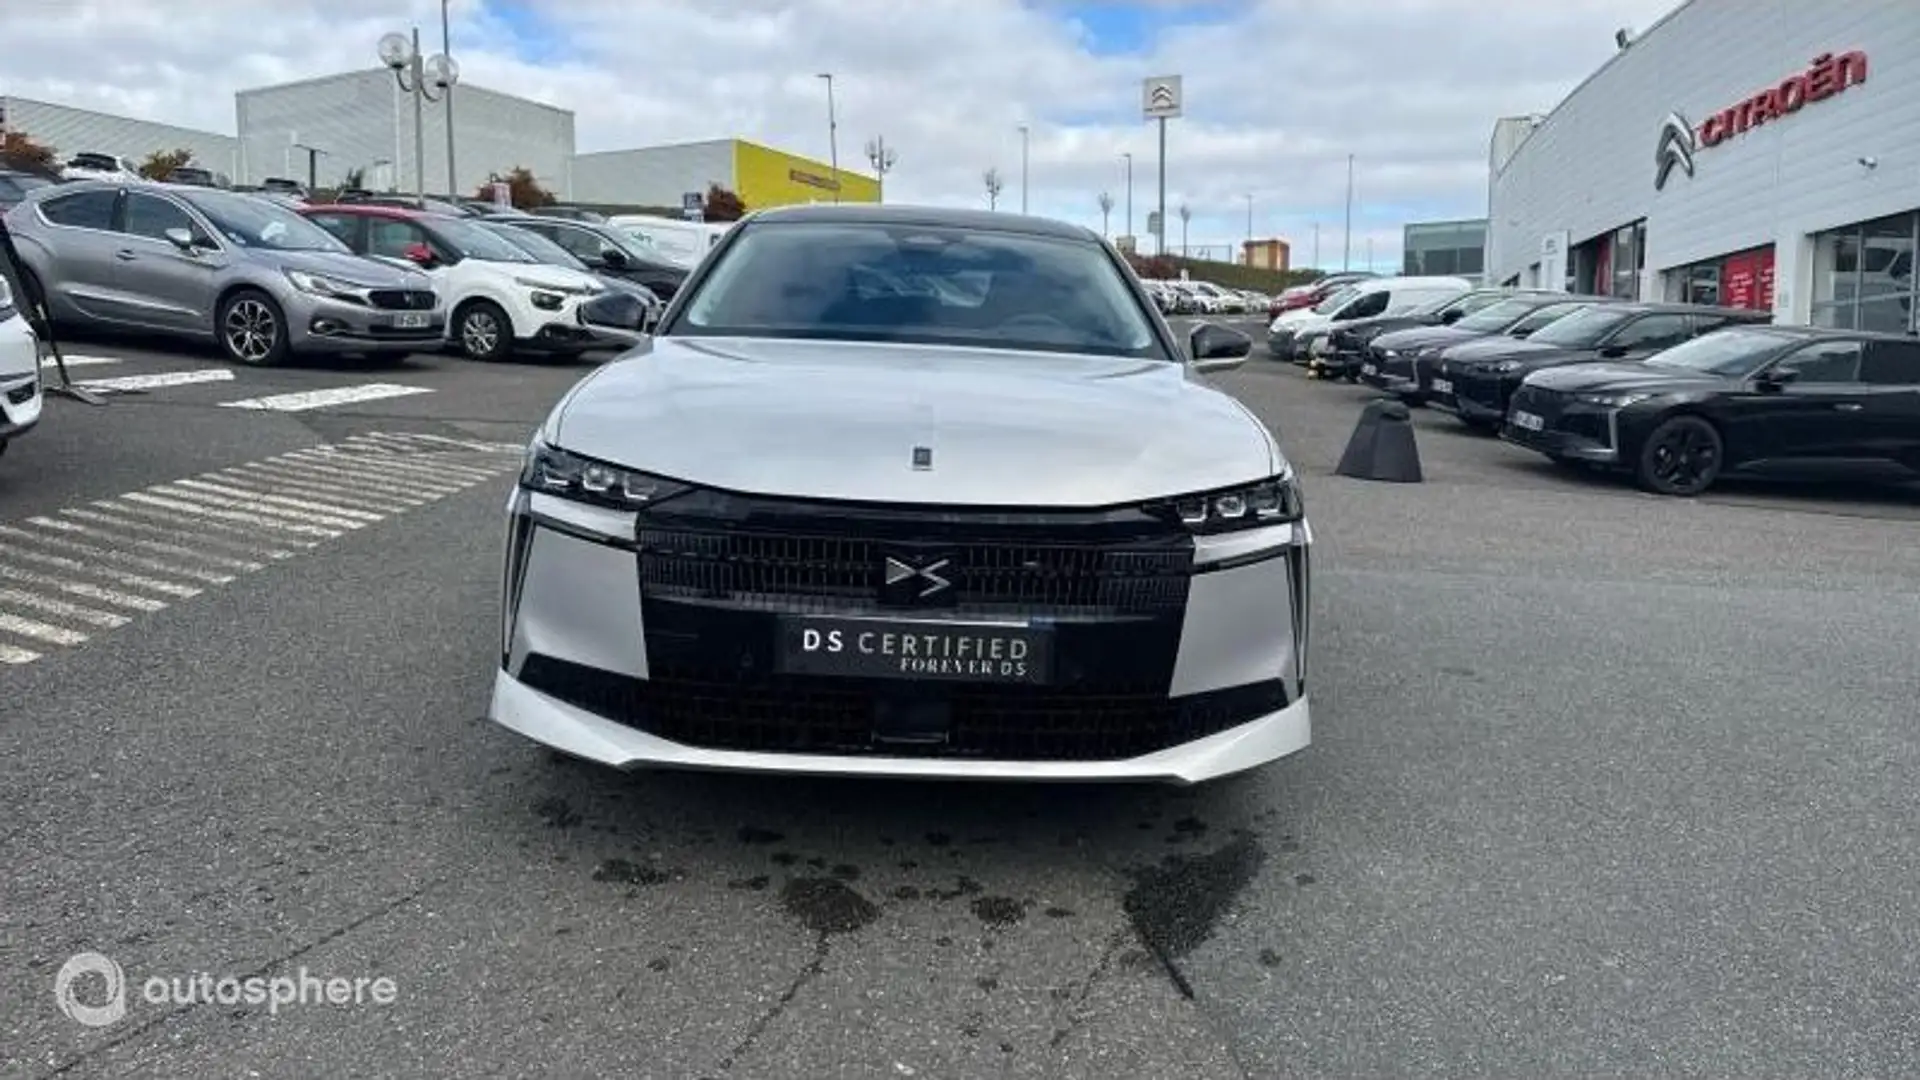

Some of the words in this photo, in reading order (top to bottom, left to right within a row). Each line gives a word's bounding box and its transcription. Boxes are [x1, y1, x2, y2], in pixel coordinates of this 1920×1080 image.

[803, 629, 843, 652] DS
[859, 632, 1027, 659] CERTIFIED
[900, 657, 993, 675] FOREVER
[1001, 661, 1026, 676] DS
